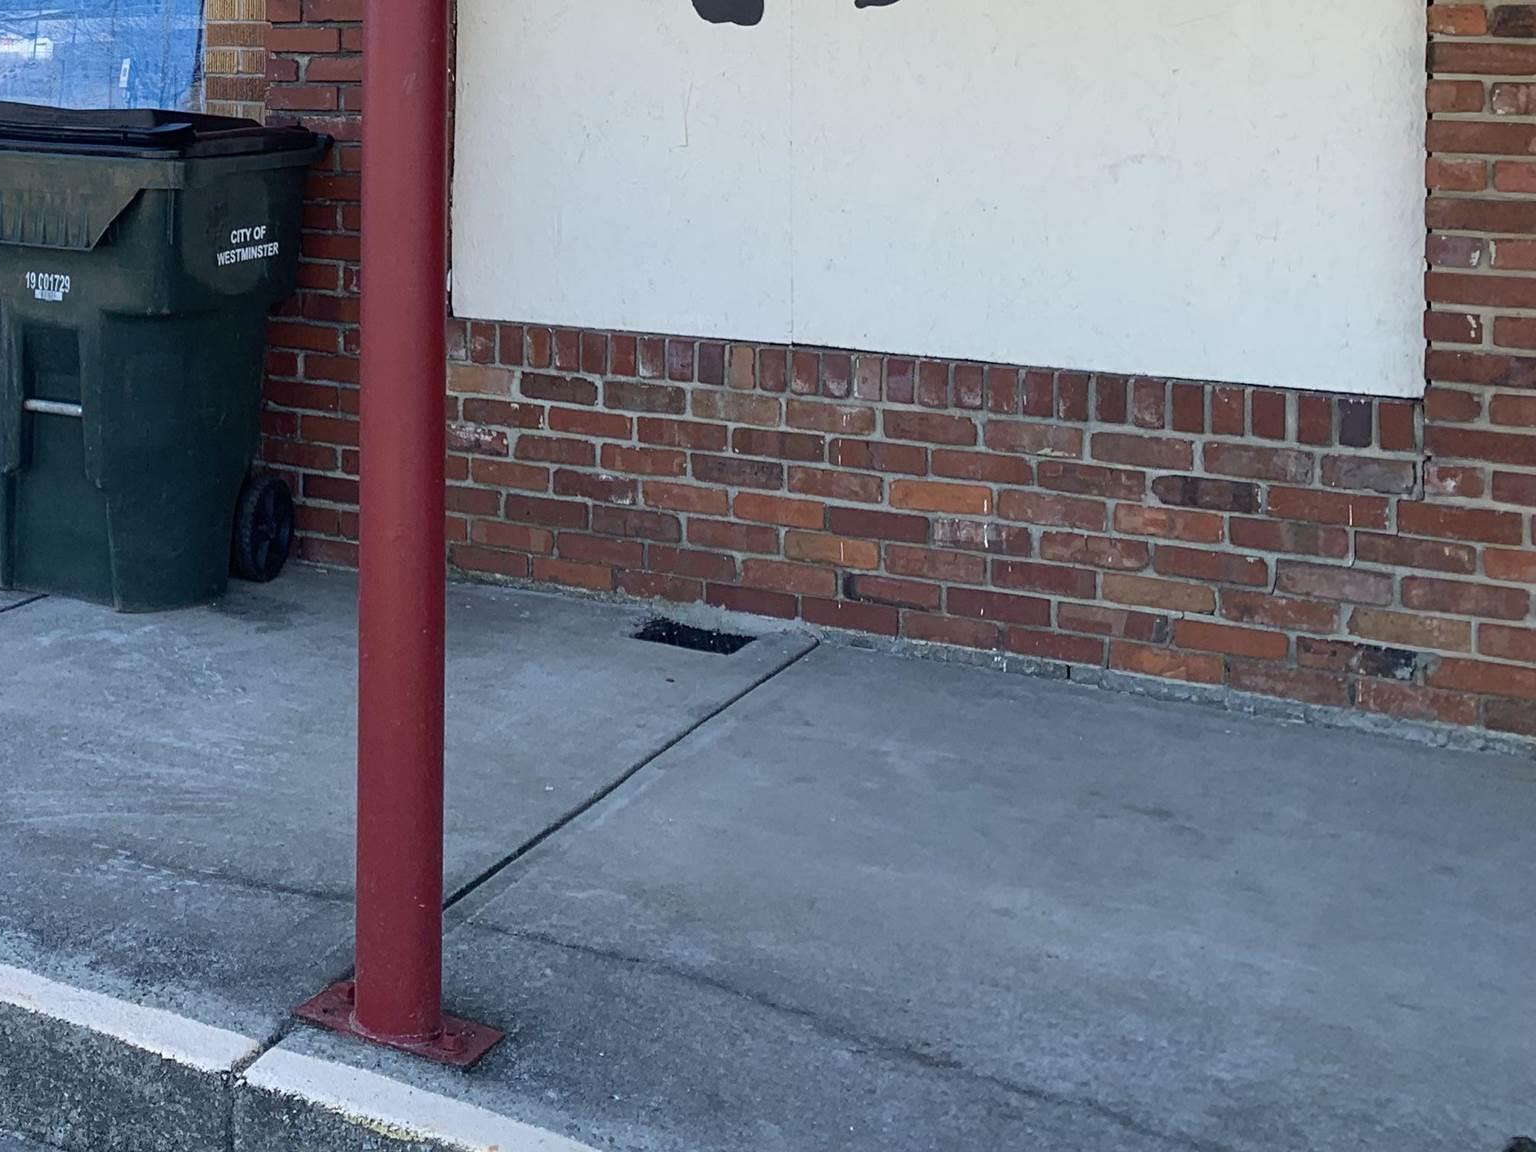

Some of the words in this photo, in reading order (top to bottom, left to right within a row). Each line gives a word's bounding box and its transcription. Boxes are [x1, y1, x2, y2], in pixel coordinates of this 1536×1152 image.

[230, 228, 252, 244] CITY
[253, 226, 266, 241] OF
[216, 242, 279, 266] WESTMINSTER
[26, 271, 36, 289] 19
